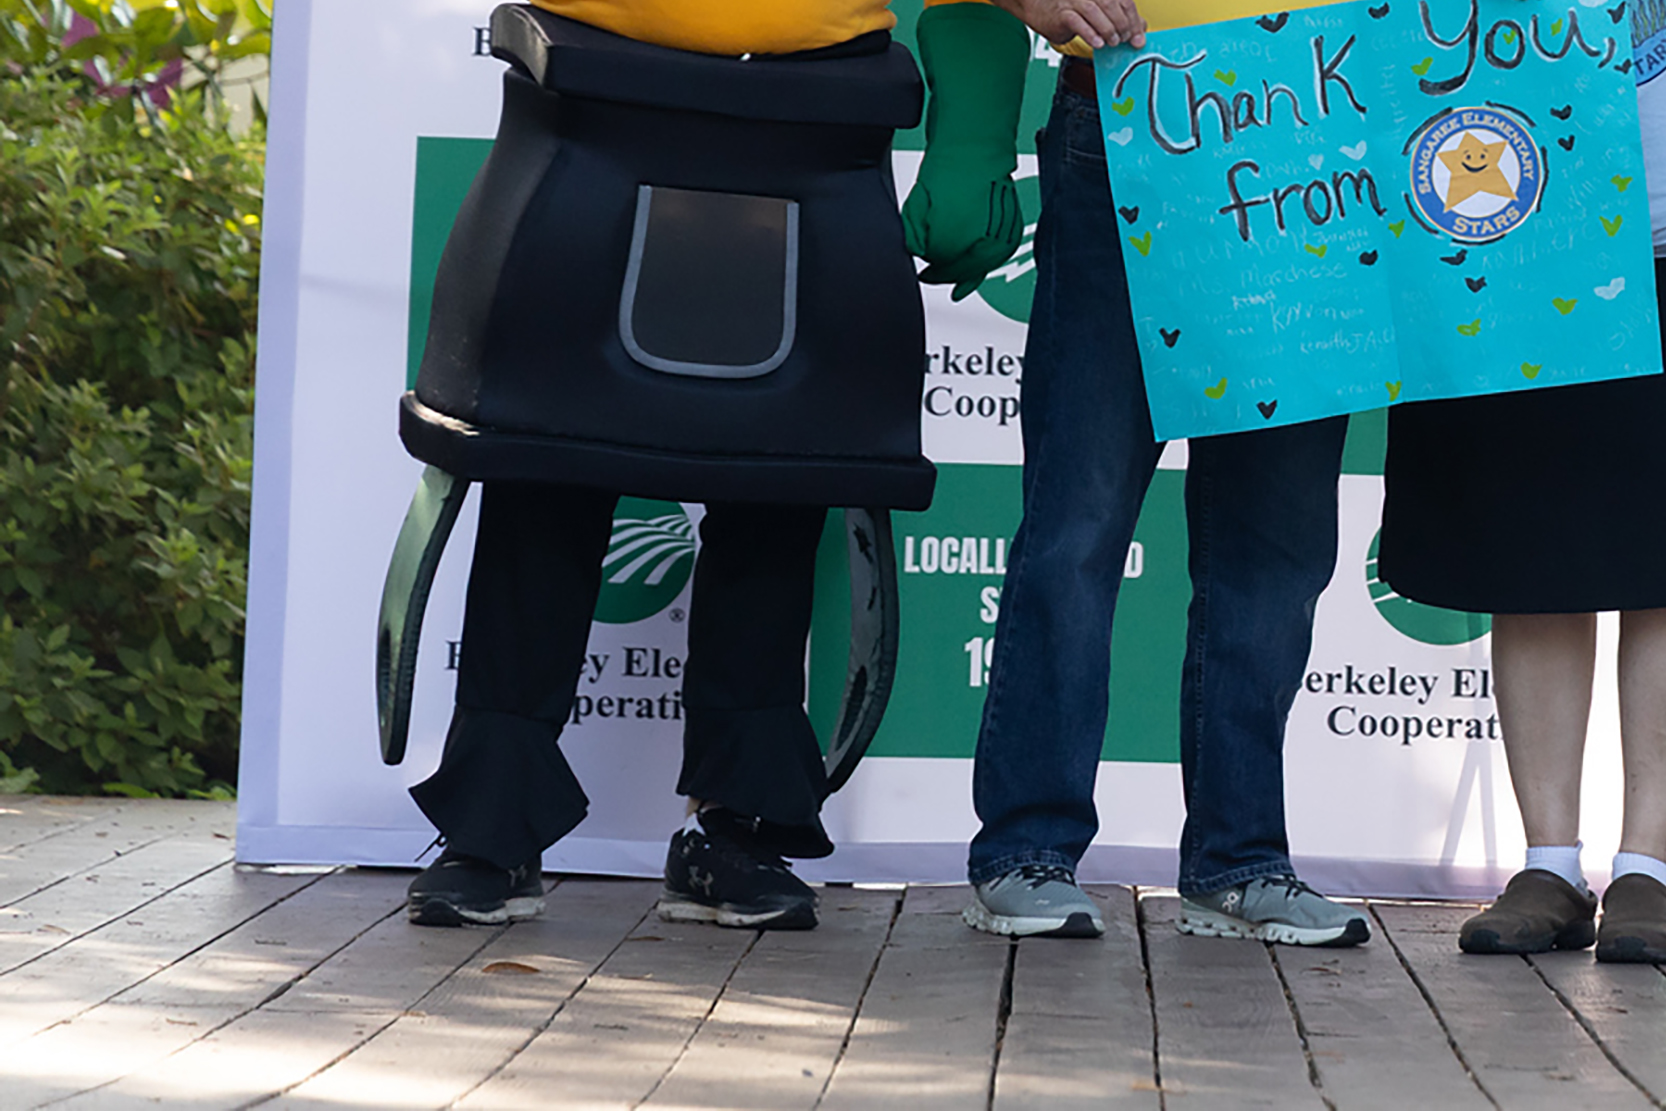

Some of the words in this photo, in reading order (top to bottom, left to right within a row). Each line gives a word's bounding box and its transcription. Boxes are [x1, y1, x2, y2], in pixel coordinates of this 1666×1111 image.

[1461, 111, 1534, 181] ELEMENTARY
[1217, 159, 1387, 242] from
[1452, 206, 1520, 235] STARS
[904, 536, 1008, 574] LOCALL
